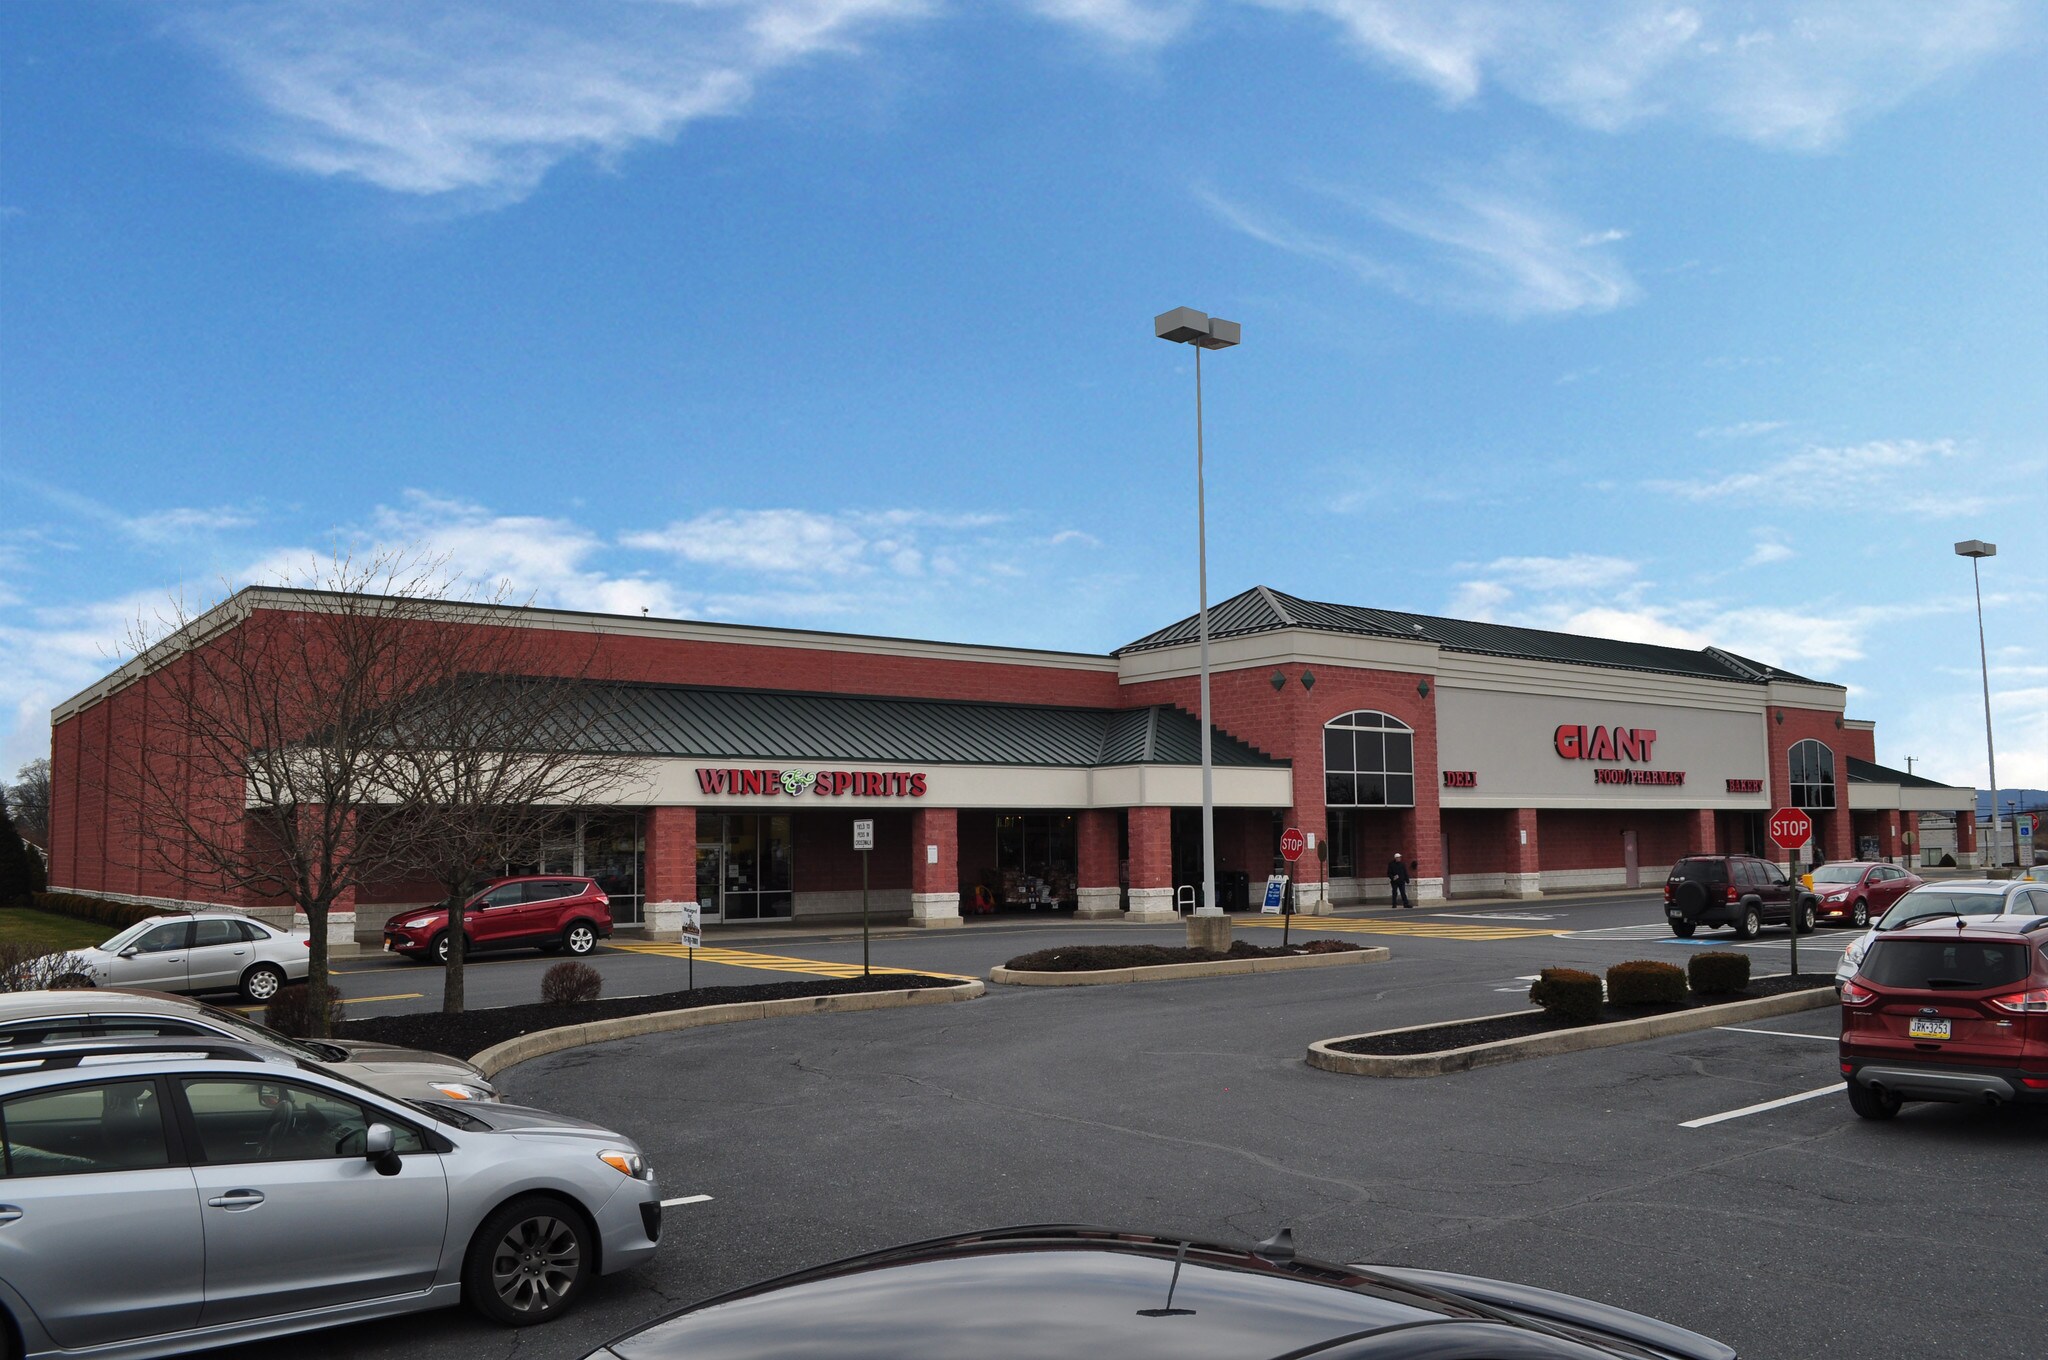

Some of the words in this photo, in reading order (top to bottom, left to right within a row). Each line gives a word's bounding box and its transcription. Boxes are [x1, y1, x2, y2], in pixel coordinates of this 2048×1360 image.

[1554, 724, 1657, 762] GIANT
[696, 768, 781, 795] WINE
[814, 770, 927, 797] SPIRITS
[1443, 770, 1478, 788] DELI
[1594, 768, 1687, 785] FOOD/PHARMACY
[1726, 778, 1764, 793] BAKERY
[1772, 820, 1808, 836] STOP
[1282, 838, 1303, 851] STOP
